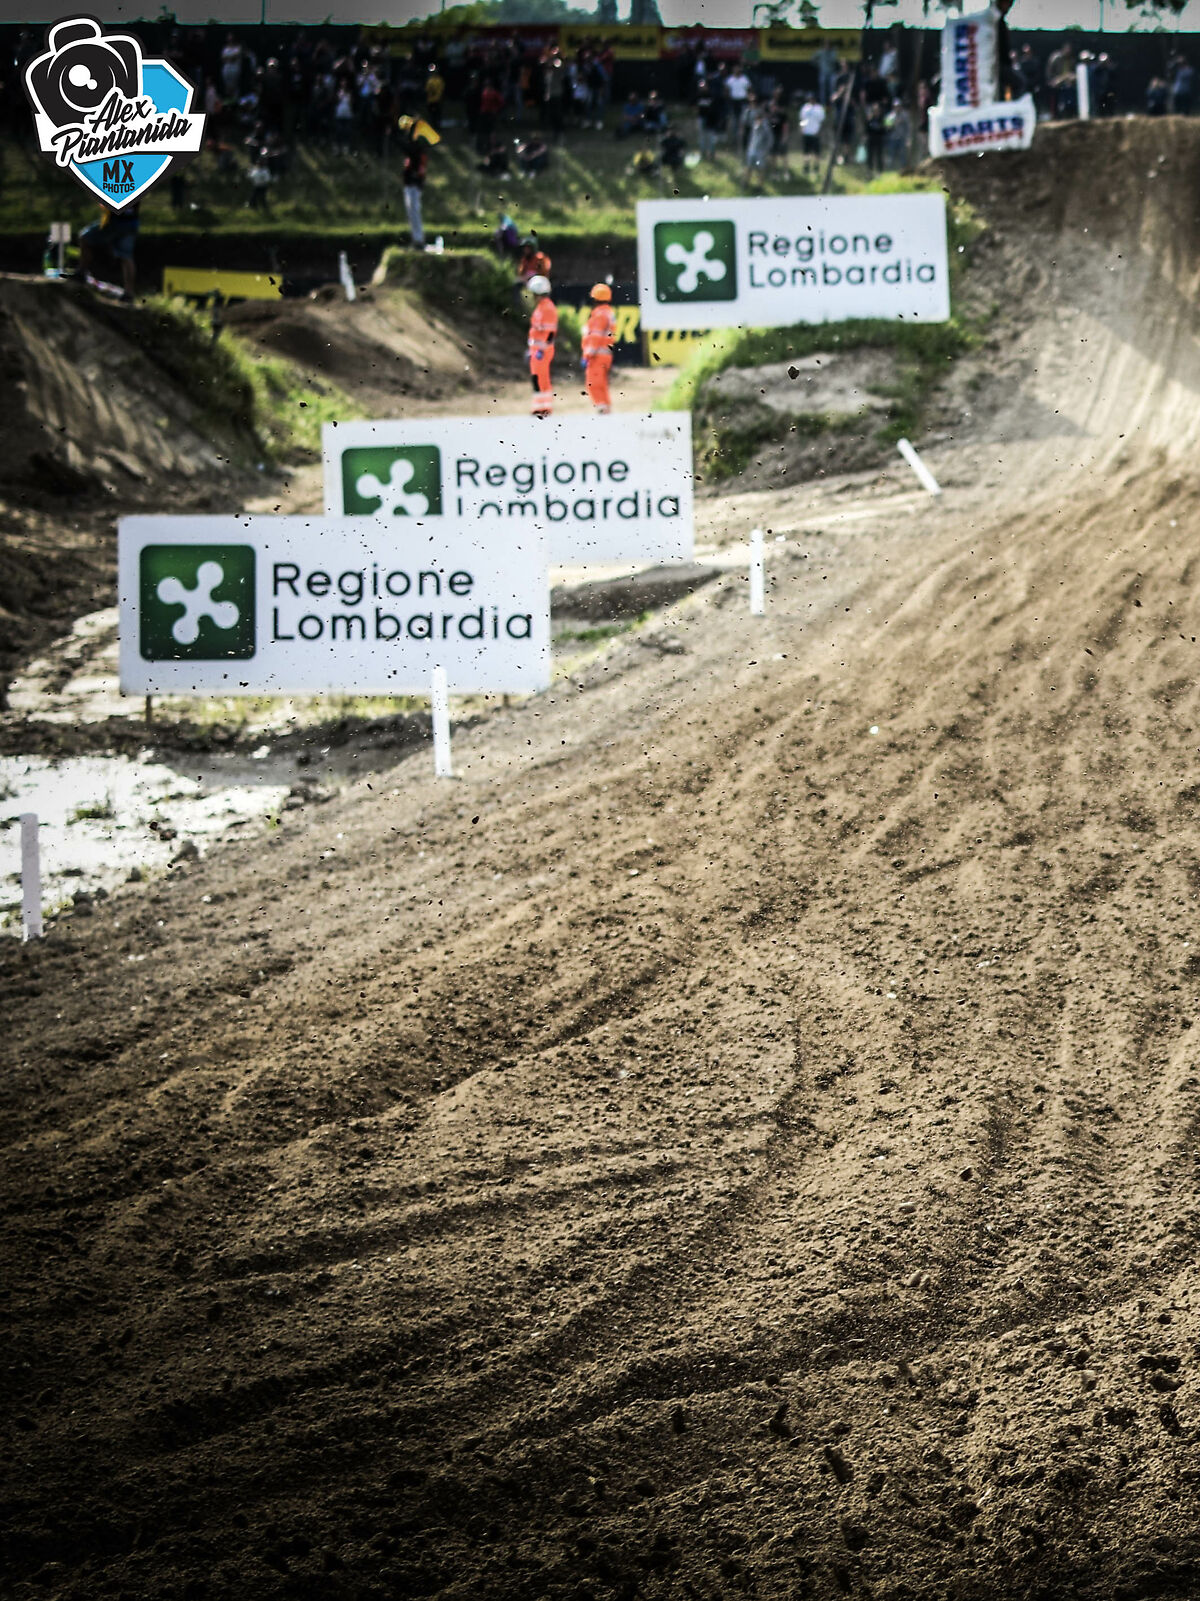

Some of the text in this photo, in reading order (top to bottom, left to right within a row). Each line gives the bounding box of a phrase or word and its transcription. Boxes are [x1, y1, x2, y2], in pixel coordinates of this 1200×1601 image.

[942, 116, 1024, 142] PARTS
[749, 231, 893, 262] Regione
[750, 260, 936, 288] Lombardia
[456, 456, 630, 494] Regione
[273, 563, 474, 605] Regione
[273, 608, 532, 641] Lombardia
